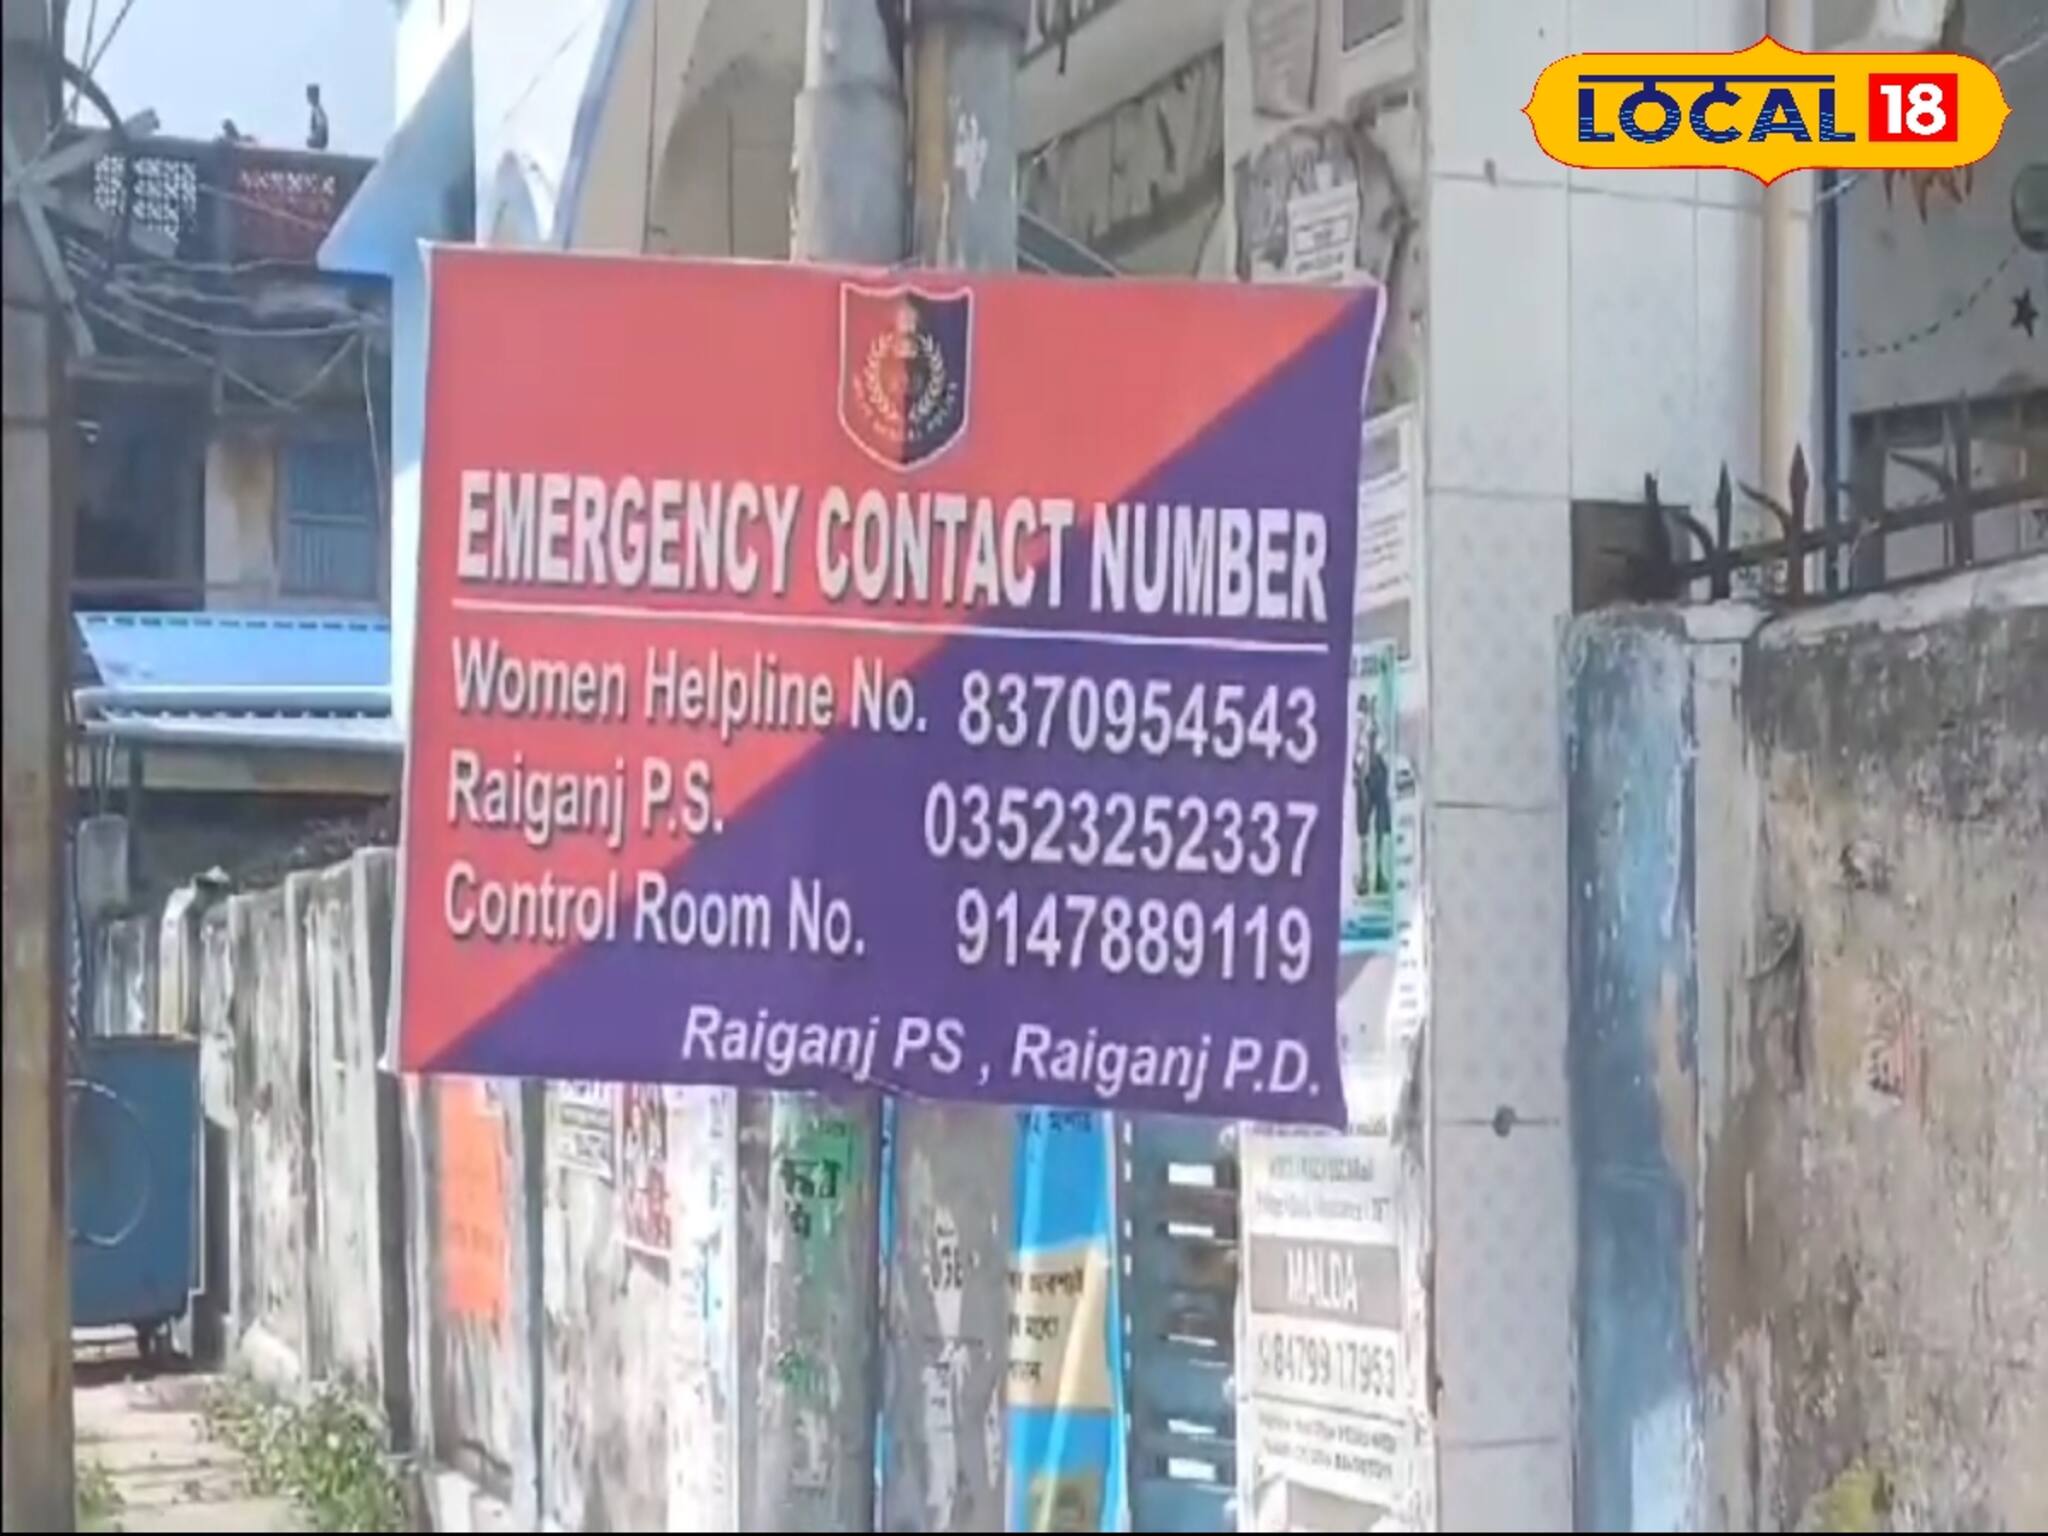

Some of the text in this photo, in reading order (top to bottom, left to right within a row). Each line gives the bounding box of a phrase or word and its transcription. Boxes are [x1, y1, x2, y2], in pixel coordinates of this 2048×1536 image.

[457, 470, 798, 594] EMERGENCY
[815, 486, 1075, 610] CONTACT
[1090, 501, 1328, 622] NUMBER
[451, 637, 1319, 762] Women Helpline No. 8370954543
[447, 749, 1319, 877] Raiganj P.S. 03523252337
[444, 861, 1313, 982] Control Room No. 9147889119
[682, 1005, 881, 1080] Raiganj
[892, 1016, 966, 1074] PS
[1011, 1022, 1211, 1100] Raiganj
[1222, 1037, 1321, 1096] P.D.
[1286, 1248, 1358, 1314] MALDA
